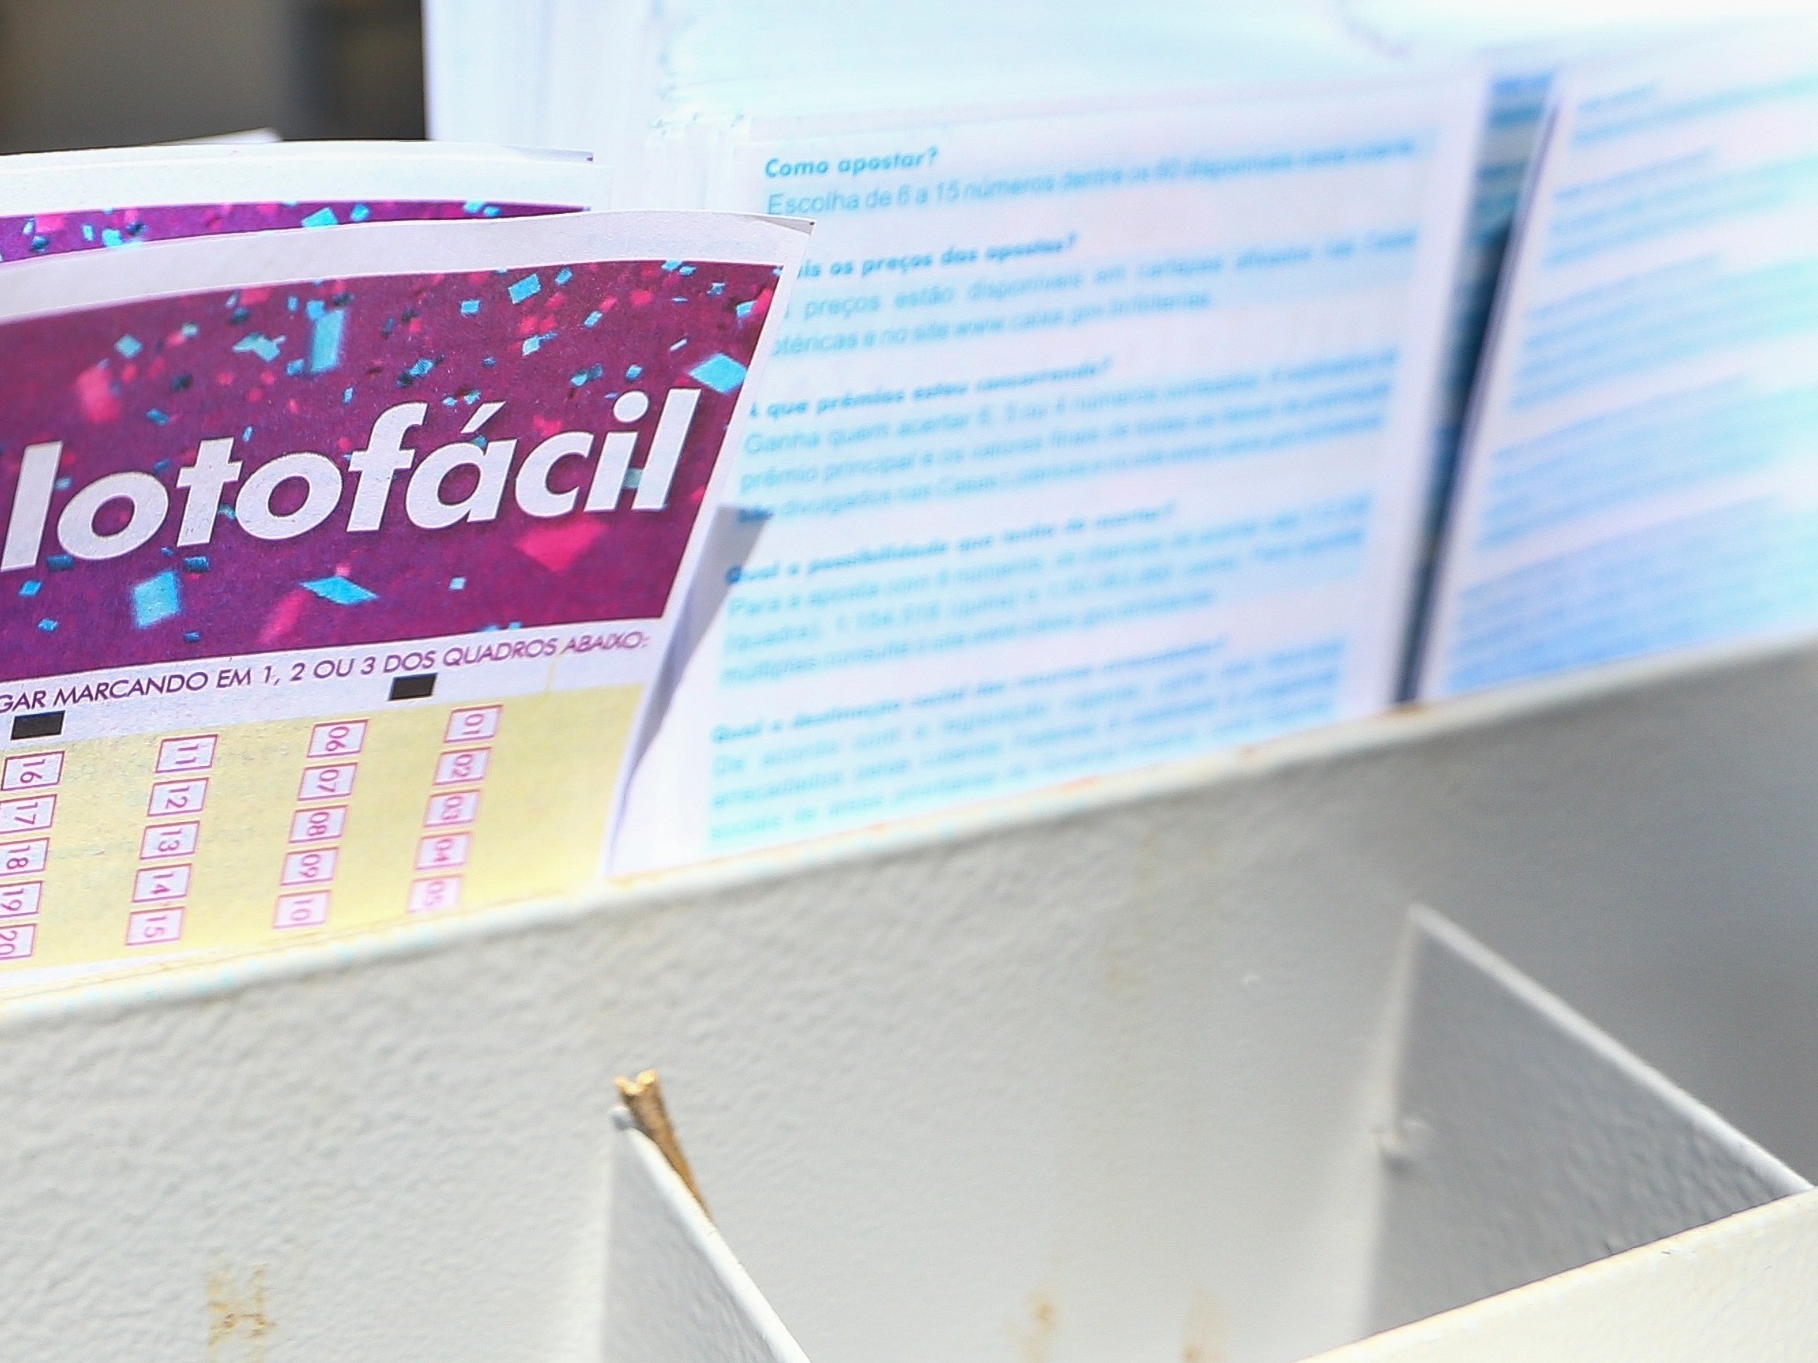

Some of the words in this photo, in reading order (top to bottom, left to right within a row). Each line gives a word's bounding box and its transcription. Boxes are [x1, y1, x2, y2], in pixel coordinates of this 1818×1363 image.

[764, 156, 829, 178] Como
[837, 146, 938, 176] apostar?
[767, 190, 859, 215] Escolha
[866, 187, 891, 209] de
[915, 188, 929, 205] a
[936, 182, 960, 204] 15
[798, 259, 821, 277] is
[861, 253, 932, 278] preços
[0, 388, 701, 572] lotofácil
[53, 671, 208, 707] MARCANDO
[216, 668, 251, 688] EM
[263, 665, 280, 687] 1,
[289, 662, 306, 682] 2
[312, 658, 354, 679] OU
[360, 655, 376, 675] 3
[383, 649, 437, 674] DOS
[442, 637, 557, 667] QUADROS
[462, 712, 485, 736] 01
[325, 725, 350, 753] 06
[174, 743, 201, 765] 11
[451, 753, 474, 778] 02
[18, 758, 47, 785] 16
[316, 768, 340, 794] 07
[165, 786, 192, 810] 12
[442, 795, 464, 821] 03
[13, 801, 39, 827] 17
[307, 811, 331, 837] 08
[157, 828, 183, 853] 13
[433, 838, 454, 863] 04
[5, 845, 31, 871] 18
[298, 853, 322, 879] 09
[152, 872, 175, 895] 14
[0, 888, 25, 913] 19
[290, 898, 314, 922] 10
[143, 915, 168, 939] 15
